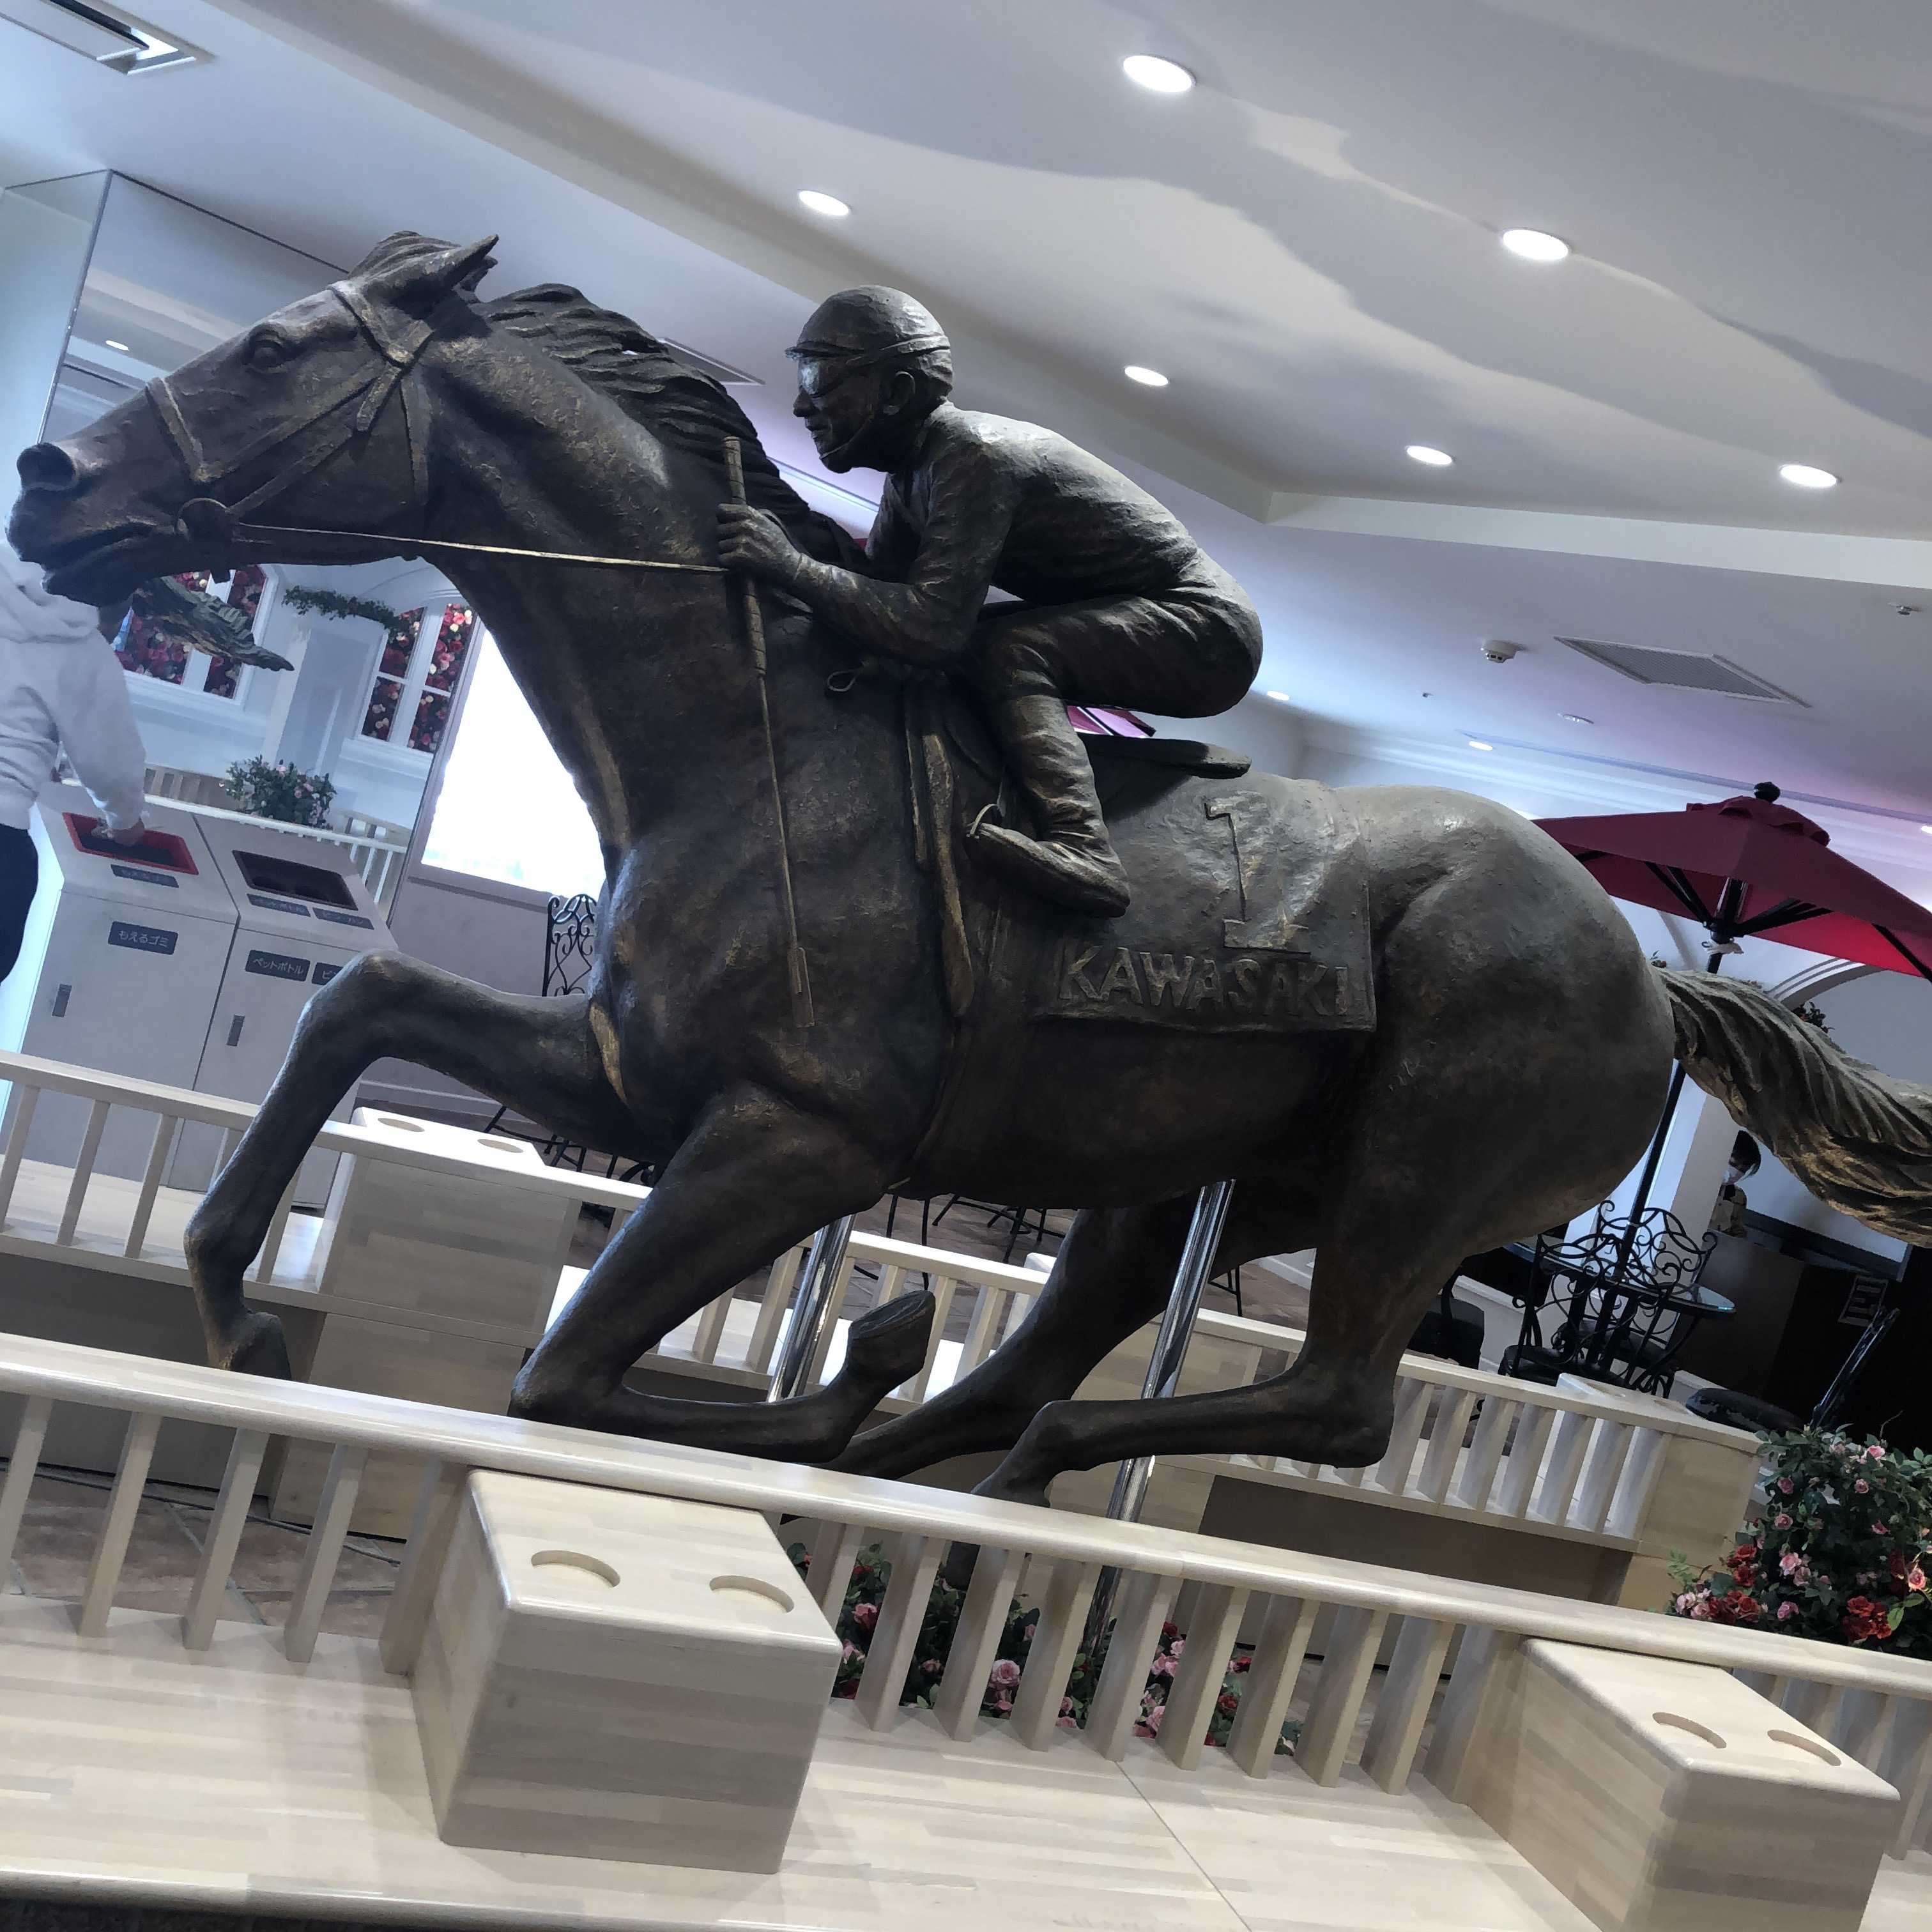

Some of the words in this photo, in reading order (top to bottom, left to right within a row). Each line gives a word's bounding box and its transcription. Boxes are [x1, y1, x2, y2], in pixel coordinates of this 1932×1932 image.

[118, 930, 169, 948] もえるゴミ
[253, 958, 304, 975] ペットボトル
[1057, 944, 1349, 1017] KAWASAKI
